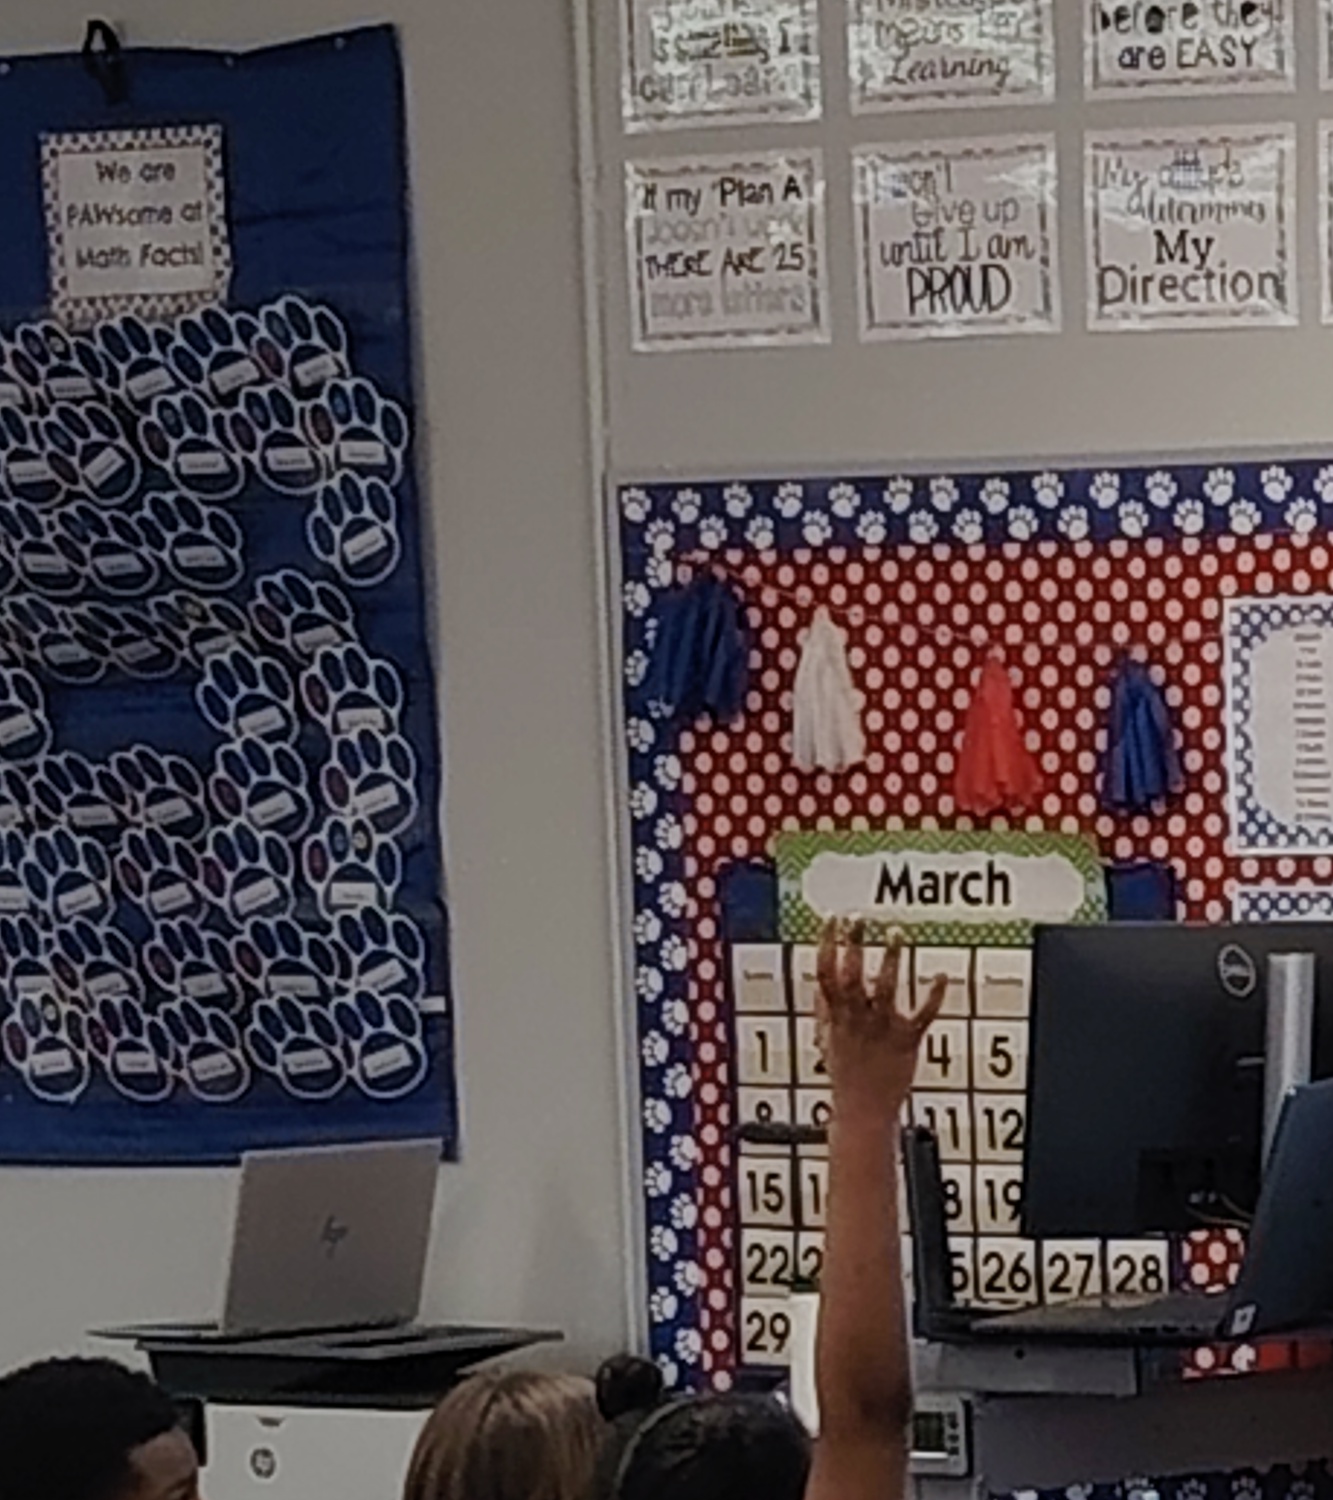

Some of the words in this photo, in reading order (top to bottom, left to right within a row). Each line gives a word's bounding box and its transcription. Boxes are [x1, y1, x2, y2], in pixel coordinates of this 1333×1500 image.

[885, 52, 1010, 89] Learning
[1117, 45, 1166, 71] are
[1176, 34, 1257, 69] EASY
[95, 160, 132, 184] We
[139, 162, 176, 184] are
[66, 202, 173, 230] PAWsome
[179, 200, 203, 223] at
[666, 187, 702, 217] my
[720, 176, 774, 207] Plan
[782, 174, 803, 202] A
[983, 196, 1021, 230] up
[75, 245, 131, 270] Math
[645, 249, 713, 280] THERE
[721, 248, 765, 277] ARE
[771, 242, 805, 271] 25
[879, 226, 946, 268] until
[957, 227, 981, 263] I
[987, 233, 1036, 261] am
[1153, 228, 1216, 271] My
[906, 262, 1013, 317] PROUD
[1099, 261, 1283, 307] Direction
[873, 858, 1012, 908] March
[754, 1030, 769, 1074] 1
[926, 1033, 951, 1078] 4
[988, 1036, 1014, 1078] 5
[923, 1106, 961, 1150] 11
[983, 1106, 1024, 1151] 12
[745, 1171, 786, 1213] 15
[984, 1179, 1022, 1221] 19
[746, 1242, 789, 1286] 22
[982, 1251, 1032, 1294] 26
[1048, 1252, 1095, 1295] 27
[1112, 1253, 1163, 1295] 28
[745, 1311, 791, 1352] 29
